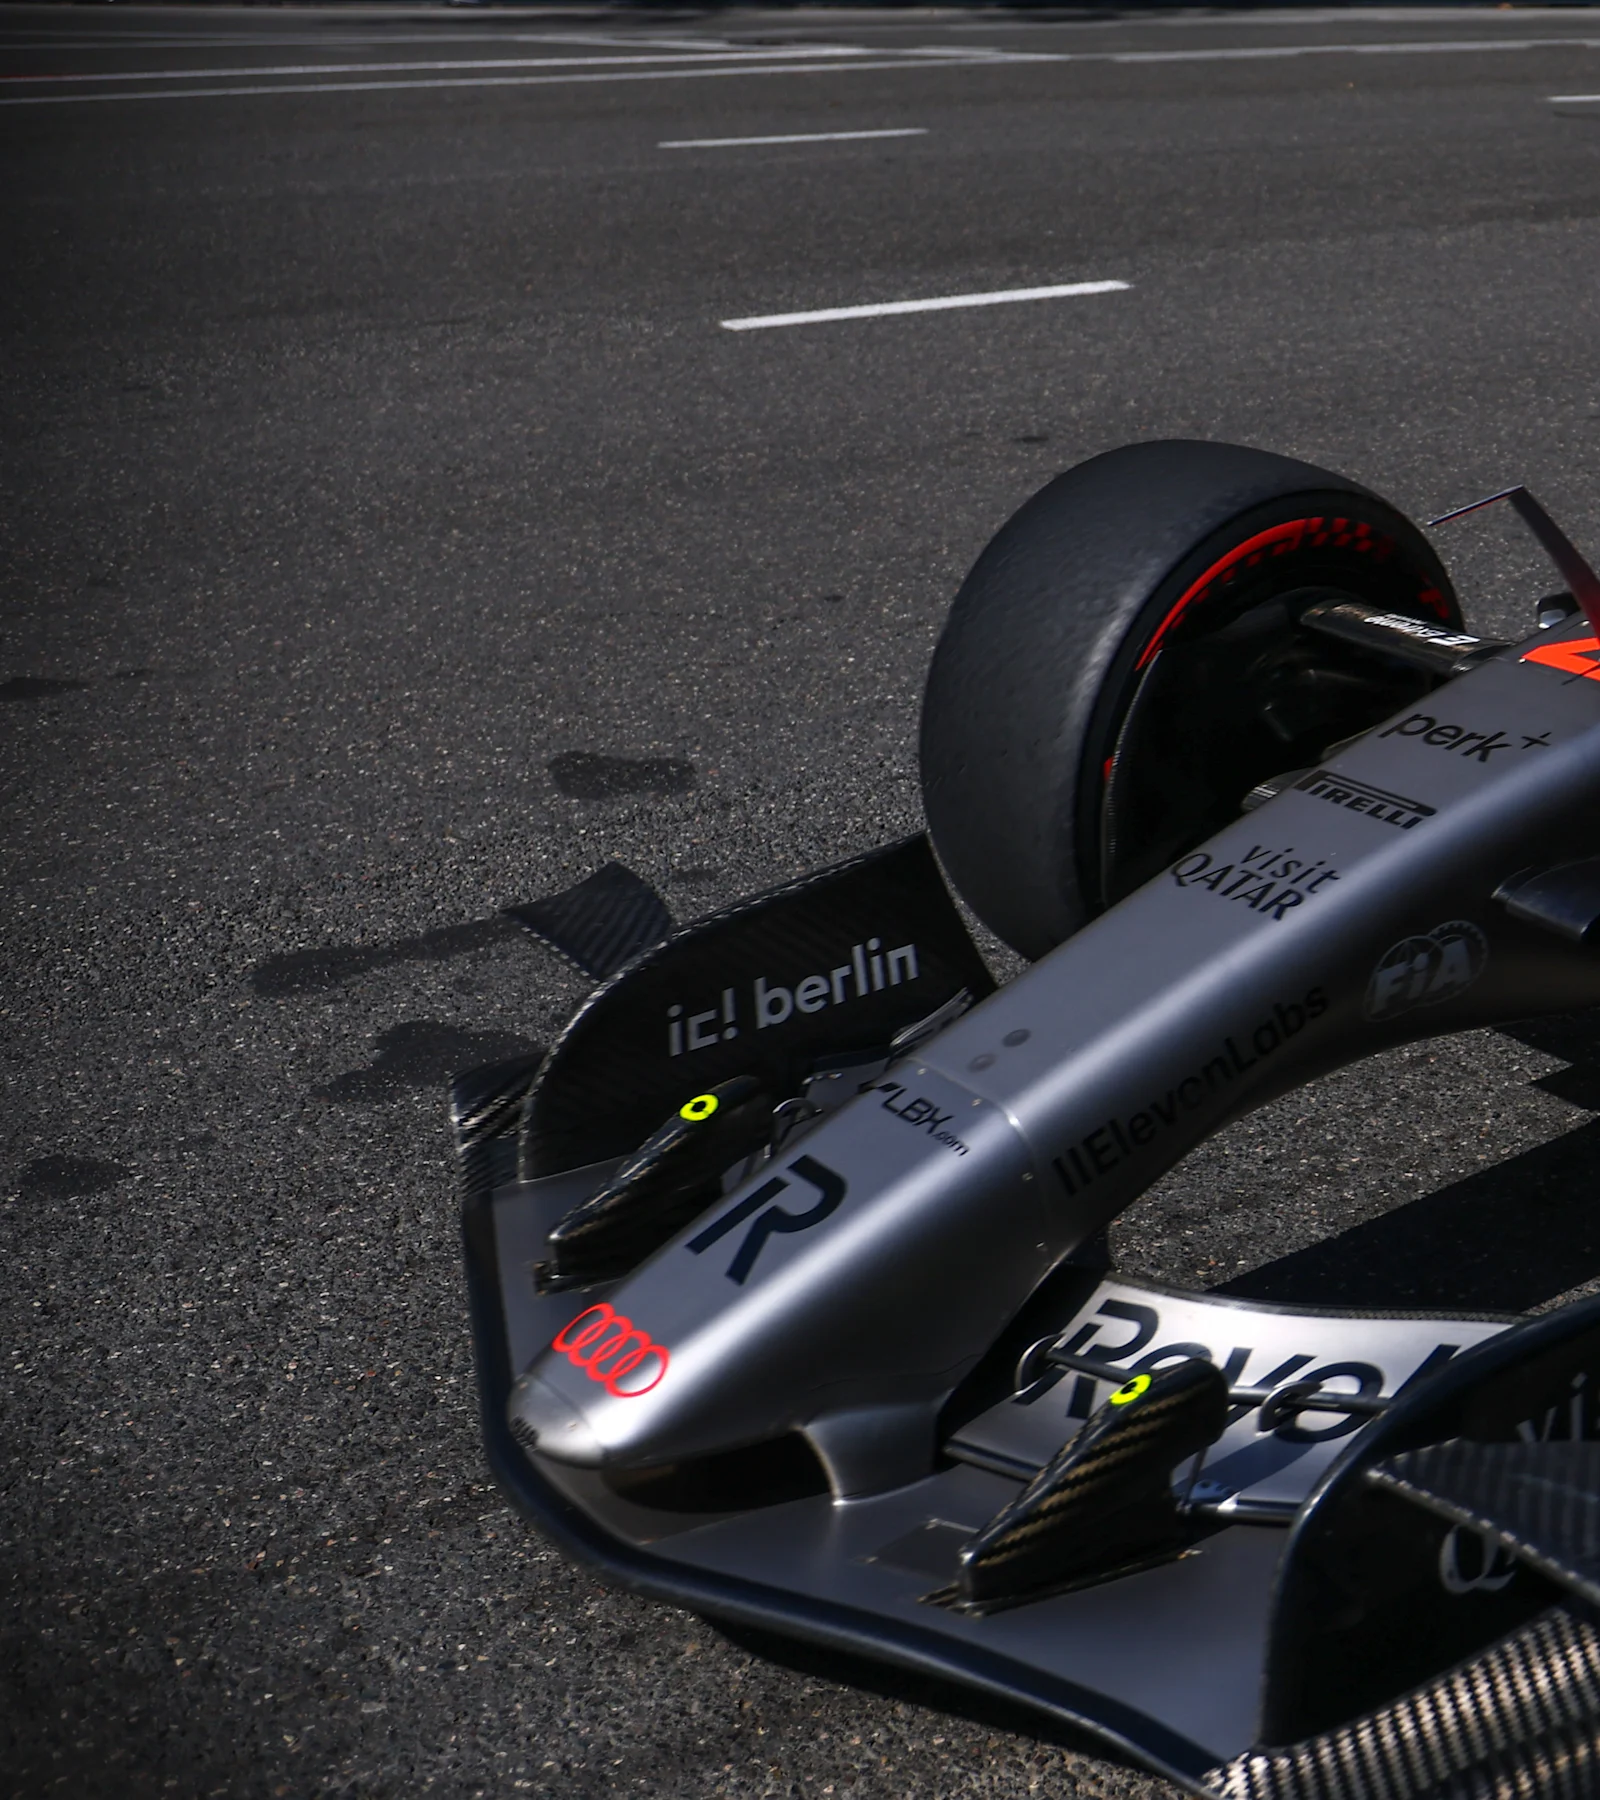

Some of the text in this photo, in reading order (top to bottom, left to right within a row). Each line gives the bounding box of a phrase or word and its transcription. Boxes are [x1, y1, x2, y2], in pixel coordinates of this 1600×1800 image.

[1293, 770, 1437, 830] PIRELLI
[1171, 853, 1304, 921] QATAR
[1241, 845, 1341, 895] visit
[754, 936, 919, 1030] berlin
